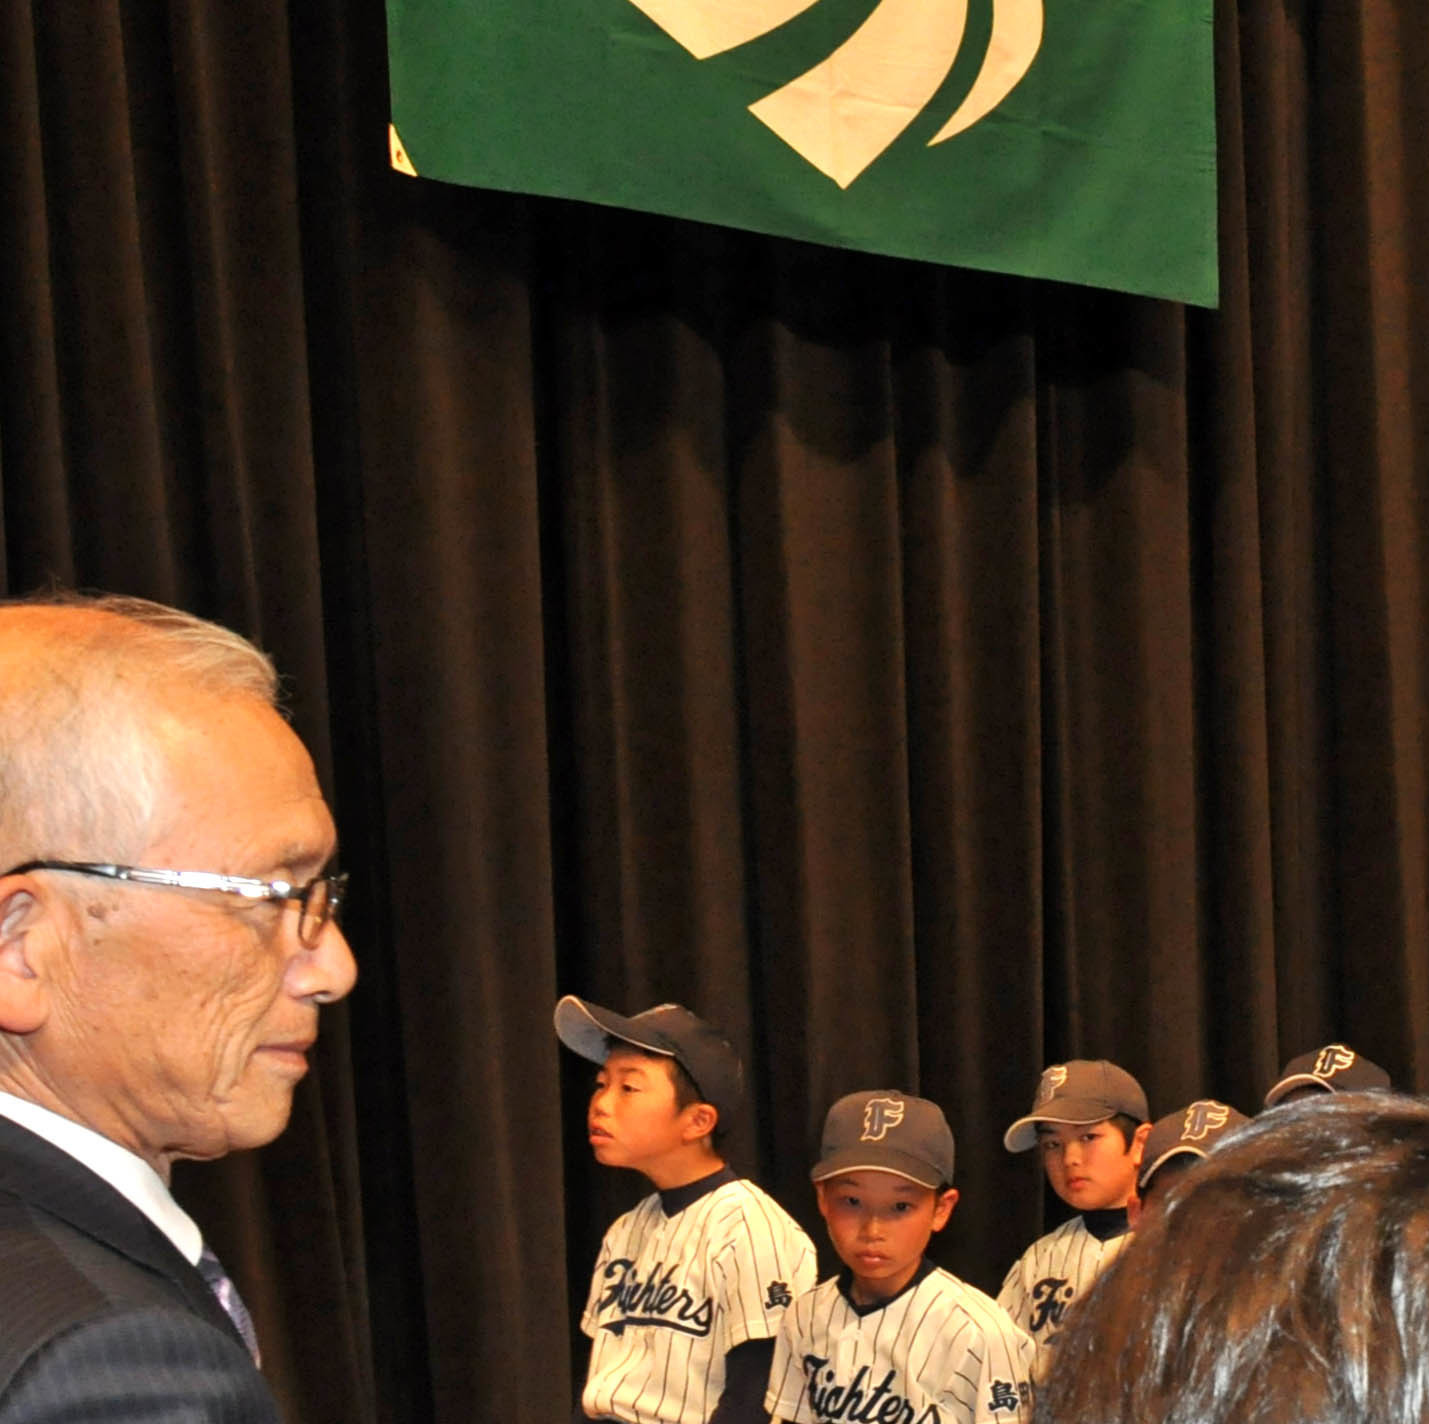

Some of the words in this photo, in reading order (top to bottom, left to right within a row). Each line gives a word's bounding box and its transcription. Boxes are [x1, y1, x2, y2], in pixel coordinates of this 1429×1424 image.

[1313, 1045, 1355, 1078] F
[1040, 1066, 1068, 1101] F
[861, 1098, 905, 1141] F
[1181, 1100, 1229, 1140] F
